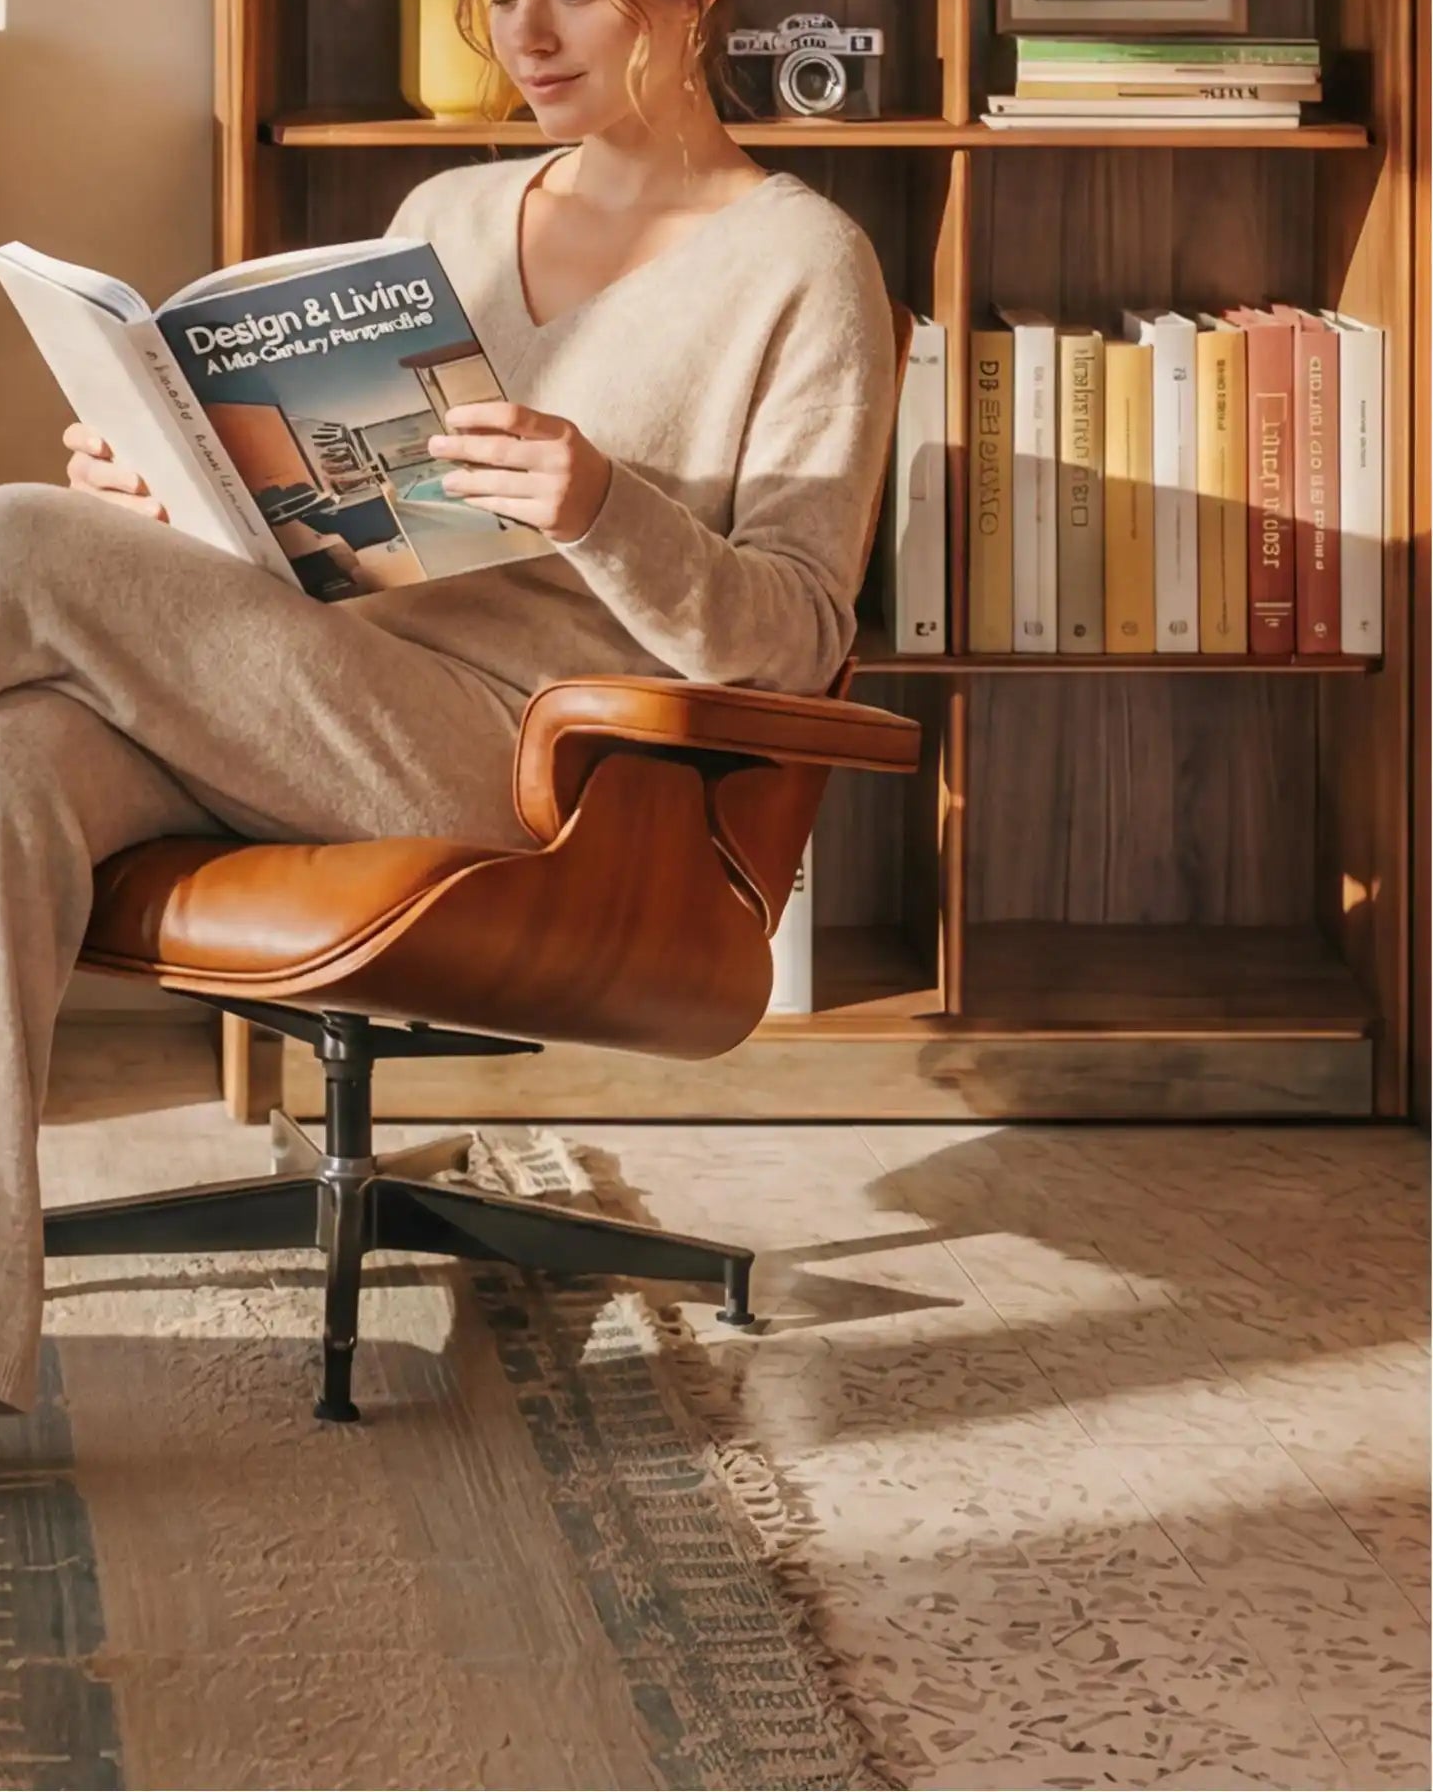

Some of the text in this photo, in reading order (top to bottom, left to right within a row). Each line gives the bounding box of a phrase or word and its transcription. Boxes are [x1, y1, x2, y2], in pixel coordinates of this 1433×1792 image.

[185, 278, 435, 356] Design & Living
[207, 358, 222, 376] A
